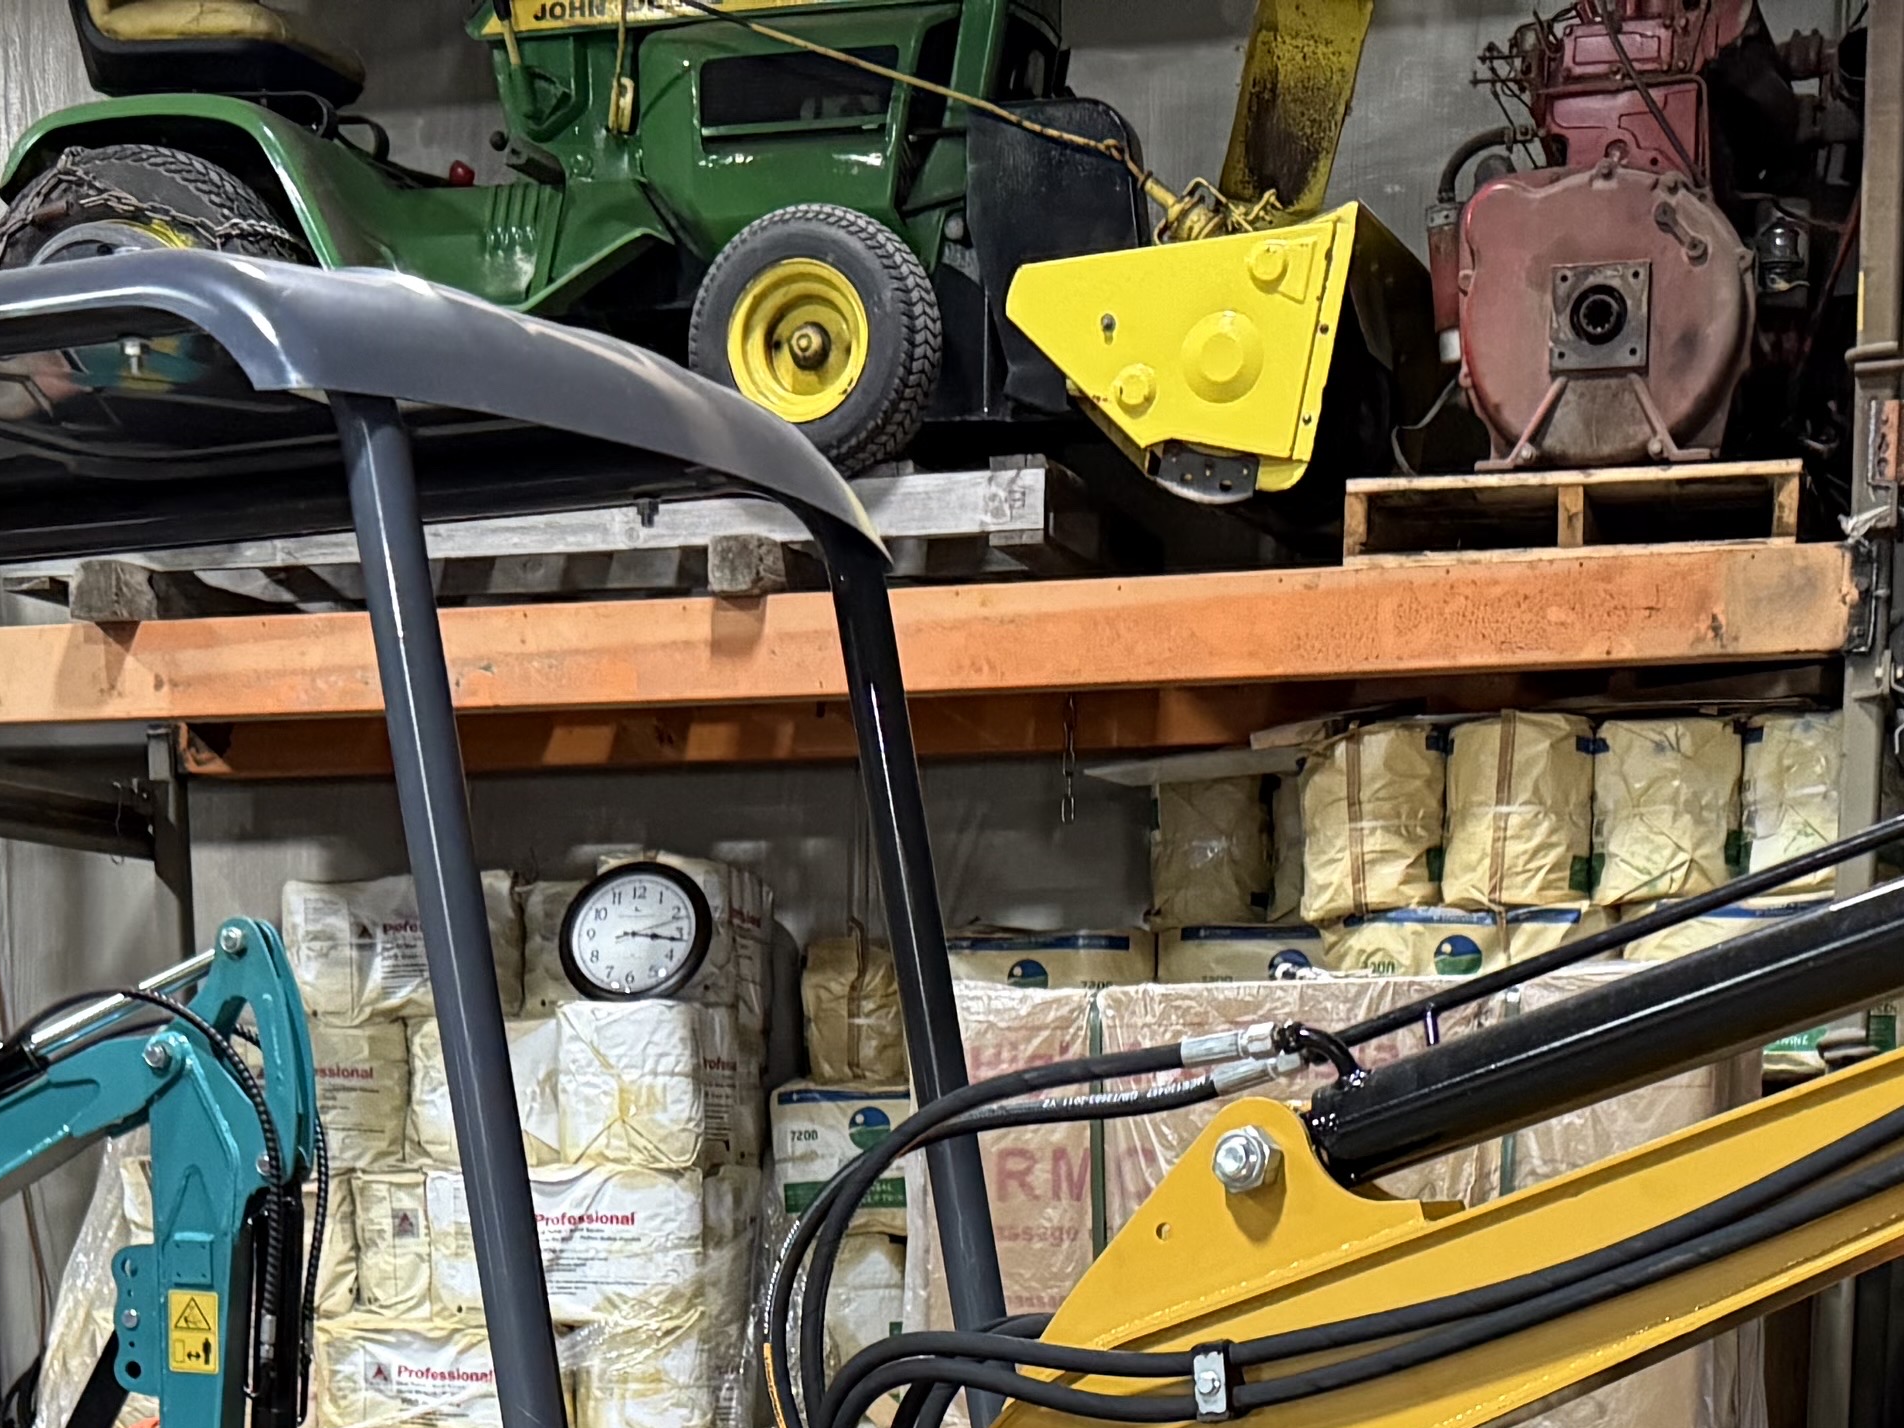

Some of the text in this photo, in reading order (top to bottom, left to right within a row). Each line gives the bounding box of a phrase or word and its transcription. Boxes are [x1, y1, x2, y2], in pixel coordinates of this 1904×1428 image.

[533, 0, 608, 22] JOHN
[612, 890, 622, 905] 11
[633, 885, 647, 900] 12
[659, 890, 664, 905] 1
[595, 907, 608, 921] 10
[671, 905, 682, 920] 2
[586, 928, 596, 941] 9
[590, 949, 599, 963] 8
[664, 948, 674, 962] 4
[605, 965, 615, 979] 7
[625, 970, 635, 985] 6
[535, 1211, 637, 1228] Professional
[396, 1364, 494, 1384] Professional
